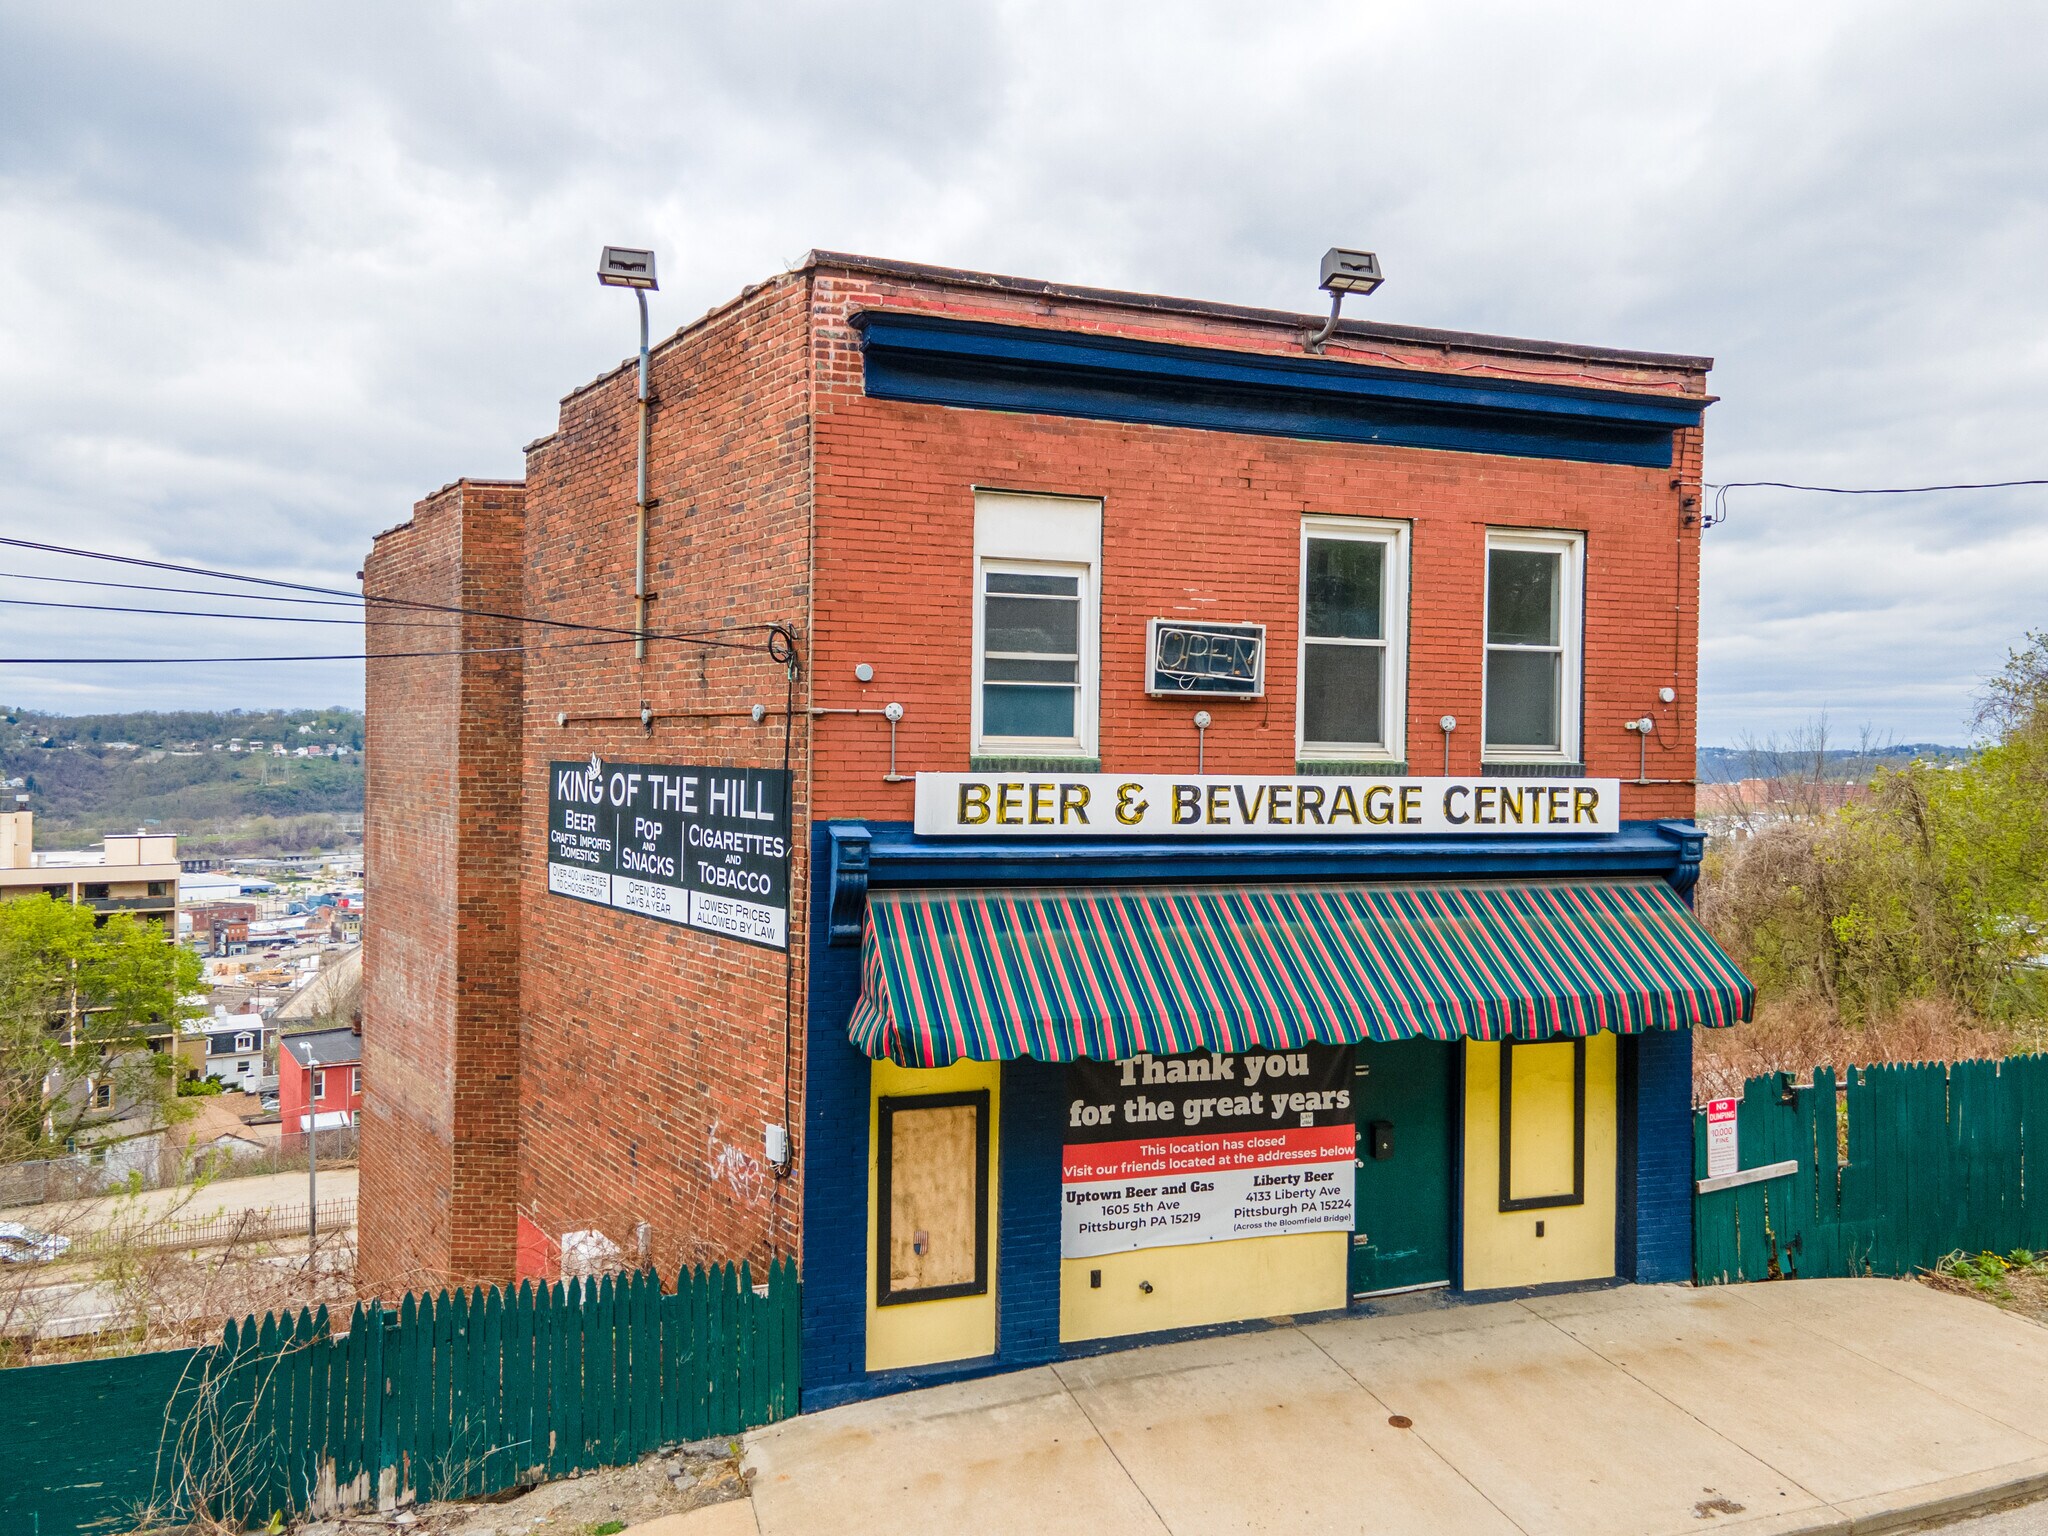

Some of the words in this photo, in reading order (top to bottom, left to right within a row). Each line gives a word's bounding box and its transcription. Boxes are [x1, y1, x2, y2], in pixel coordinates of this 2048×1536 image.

[1161, 631, 1256, 676] OPEN
[558, 770, 603, 804] KING
[610, 772, 641, 807] OF
[648, 775, 698, 814] THE
[709, 778, 774, 821] HILL
[957, 783, 1091, 825] BEER
[1115, 783, 1149, 825] &
[1172, 784, 1422, 825] BEVERAGE
[1443, 785, 1599, 825] CENTER
[565, 809, 596, 833] BEER
[635, 817, 662, 841] POP
[551, 830, 577, 846] CRAFTS
[579, 834, 611, 851] IMPORTS
[642, 842, 656, 852] AND
[689, 824, 784, 858] CIGARETTES
[560, 844, 600, 863] DOMESTICS
[622, 847, 674, 877] SNACKS
[725, 854, 742, 865] AND
[553, 866, 567, 878] OVER
[568, 869, 579, 881] 400
[579, 873, 607, 888] VARIETIES
[697, 861, 771, 895] TOBACCO
[556, 879, 564, 889] TO
[564, 881, 586, 895] CHOOSE
[587, 886, 603, 898] FROM
[629, 881, 649, 897] OPEN
[650, 886, 666, 901] 365
[626, 895, 644, 908] DAYS
[645, 900, 650, 909] A
[651, 902, 671, 915] YEAR
[699, 896, 733, 916] LOWEST
[736, 904, 771, 924] PRICES
[697, 912, 737, 931] ALLOWED
[740, 921, 752, 934] BY
[754, 922, 776, 940] LAW
[1115, 1053, 1234, 1087] Thank
[1244, 1053, 1310, 1087] you
[1069, 1099, 1116, 1127] for
[1123, 1095, 1175, 1123] the
[1182, 1092, 1264, 1126] great
[1271, 1089, 1350, 1120] years
[1709, 1110, 1735, 1121] DUMPING
[1716, 1102, 1728, 1110] NO
[1140, 1143, 1167, 1156] This
[1169, 1139, 1219, 1154] location
[1222, 1139, 1244, 1150] has
[1247, 1135, 1286, 1149] closed
[1063, 1164, 1093, 1178] Visit
[1096, 1164, 1119, 1175] our
[1121, 1158, 1166, 1173] friends
[1169, 1155, 1216, 1169] located
[1218, 1154, 1231, 1165] at
[1233, 1152, 1254, 1164] the
[1257, 1147, 1317, 1162] addresses
[1320, 1145, 1355, 1158] below
[1253, 1174, 1300, 1187] Liberty
[1304, 1171, 1334, 1183] Beer
[1066, 1190, 1121, 1205] Uptown
[1125, 1186, 1158, 1199] Beer
[1161, 1181, 1186, 1196] and
[1190, 1180, 1214, 1193] Gas
[1245, 1191, 1272, 1202] 4133
[1275, 1188, 1316, 1200] Liberty
[1319, 1186, 1341, 1196] Ave
[1101, 1204, 1130, 1216] 1605
[1133, 1201, 1153, 1213] 5th
[1157, 1200, 1180, 1211] Ave
[1234, 1203, 1298, 1219] Pittsburgh
[1301, 1202, 1318, 1212] PA
[1320, 1198, 1352, 1211] 15224
[1079, 1217, 1146, 1234] Pittsburgh
[1150, 1215, 1167, 1227] PA
[1170, 1212, 1201, 1225] 15219
[1233, 1222, 1262, 1232] (Across
[1264, 1220, 1278, 1228] the
[1279, 1216, 1322, 1227] Bloomfield
[1323, 1213, 1352, 1224] Bridge)
